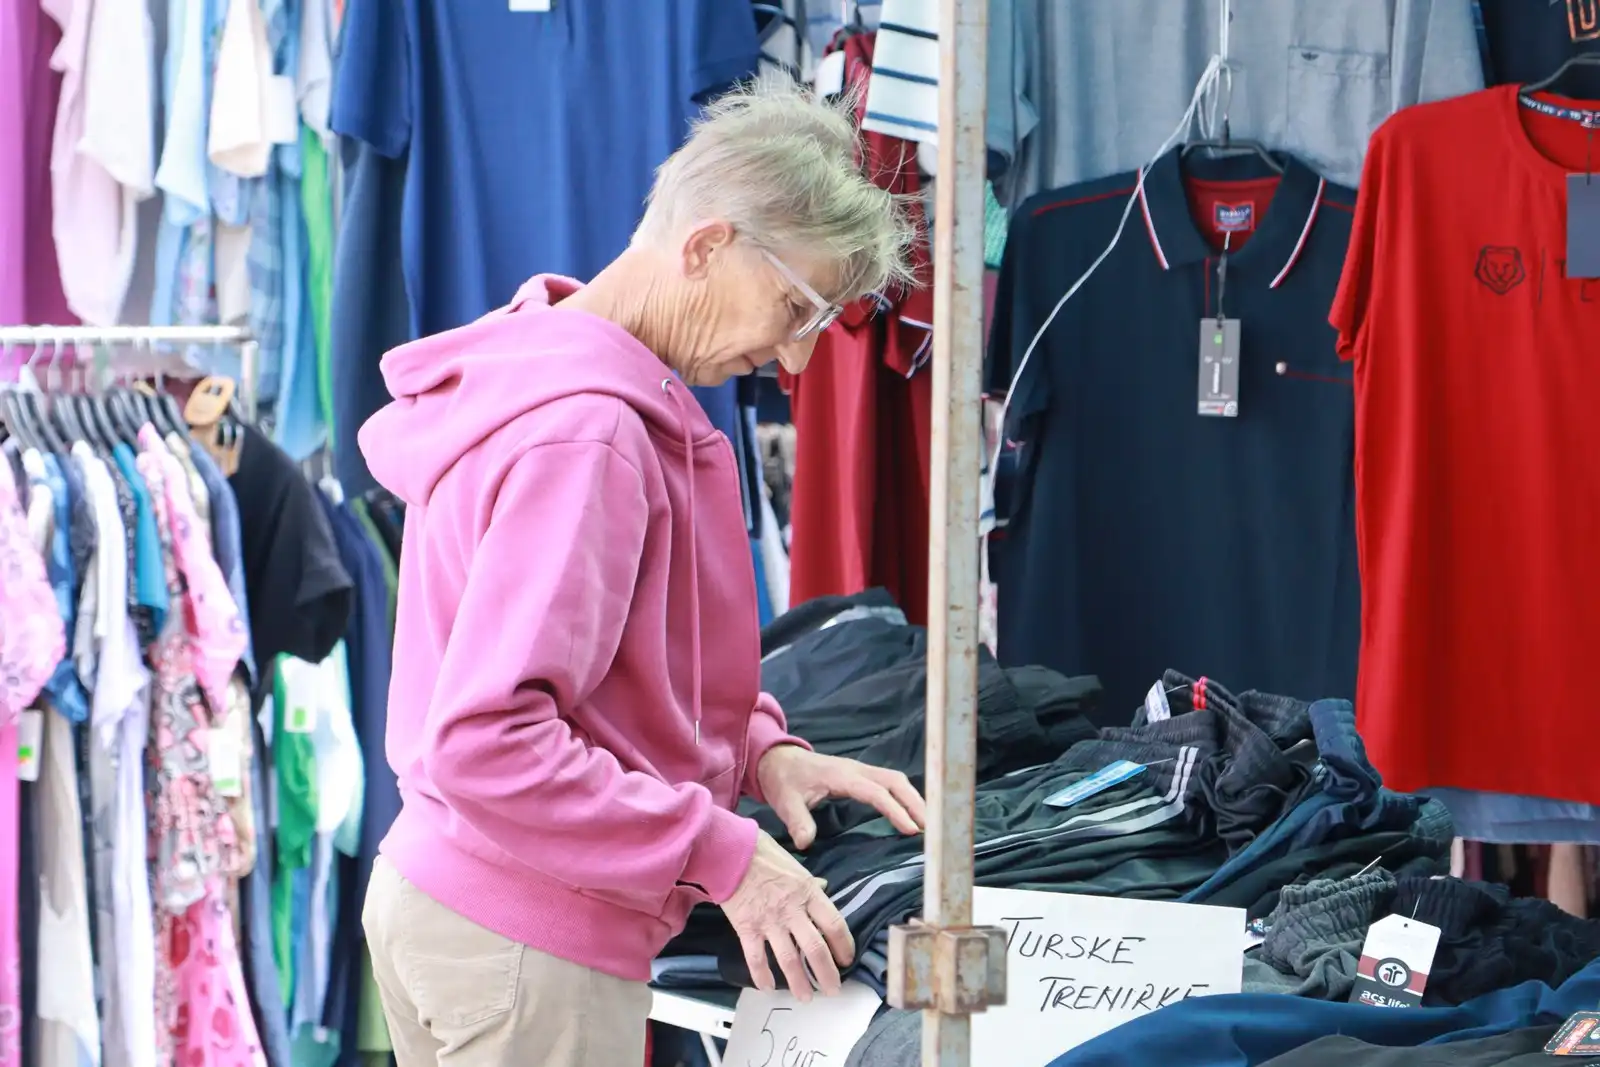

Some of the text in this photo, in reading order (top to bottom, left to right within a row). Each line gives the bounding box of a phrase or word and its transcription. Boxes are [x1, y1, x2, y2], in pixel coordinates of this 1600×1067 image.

[1001, 916, 1146, 964] TURSKE
[1361, 990, 1386, 1004] acs
[746, 1007, 793, 1067] 5
